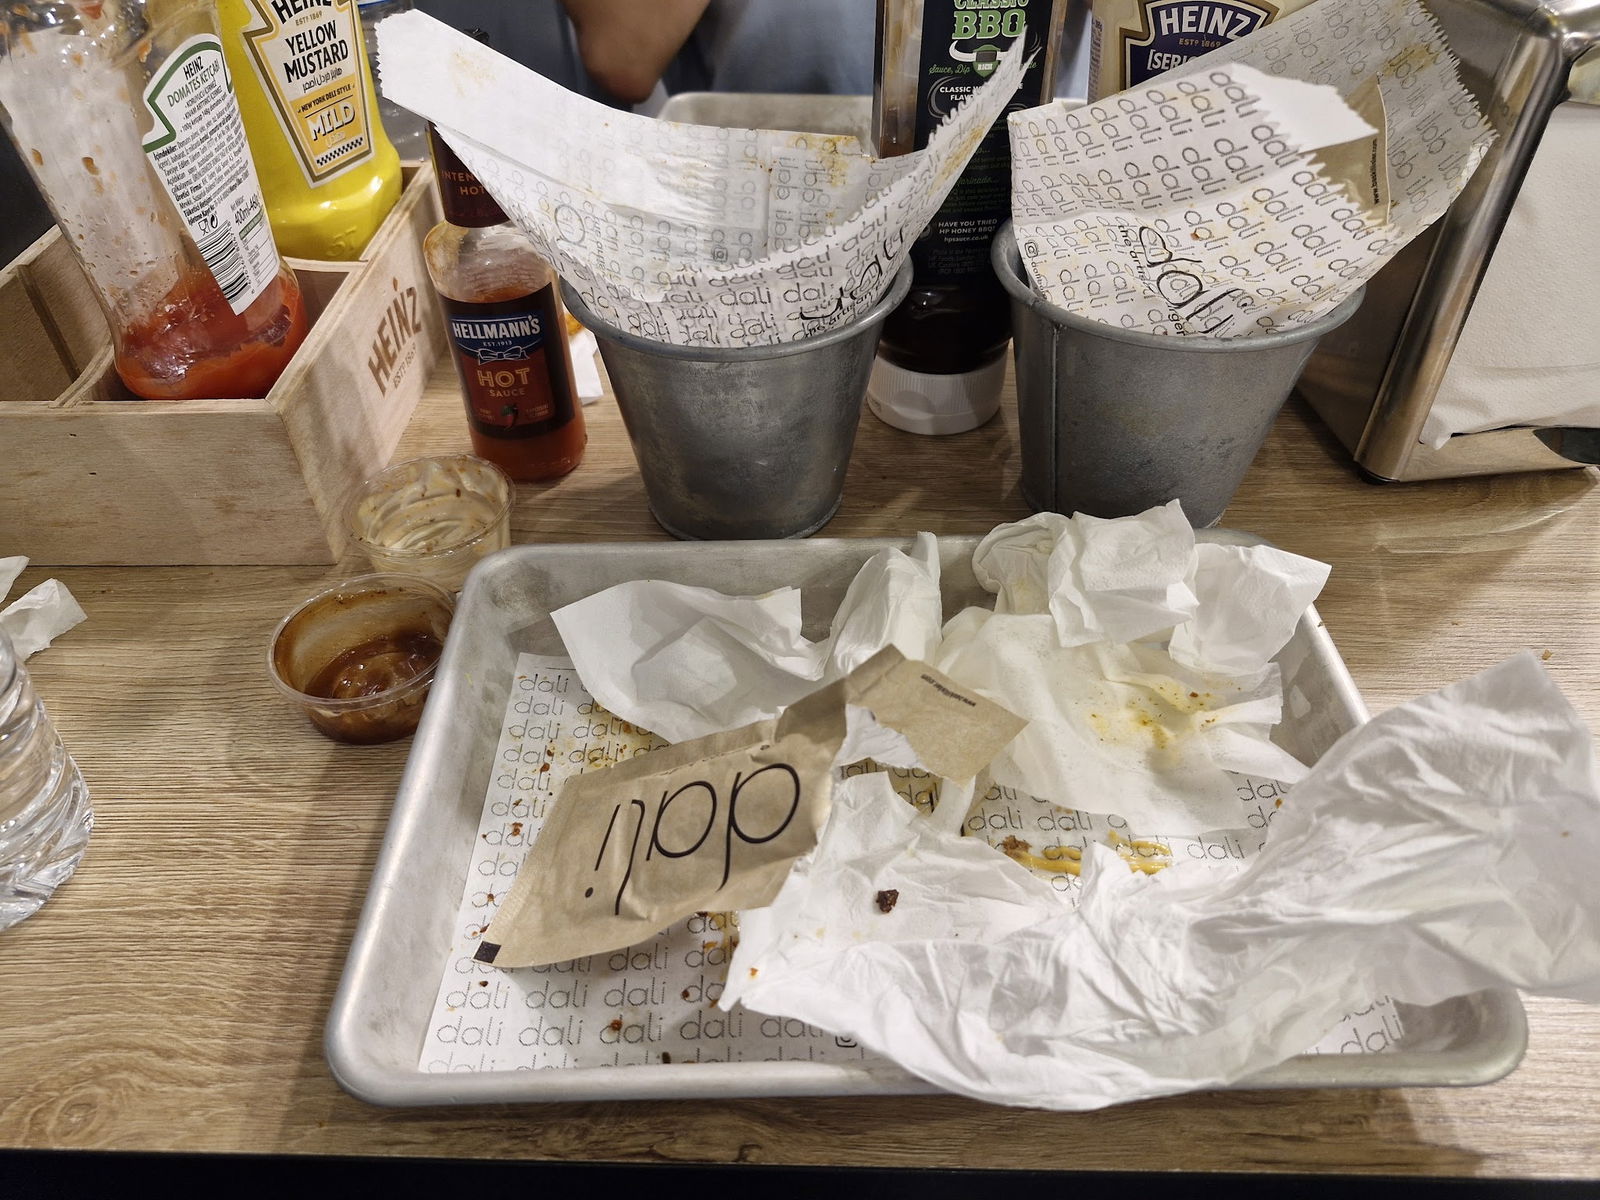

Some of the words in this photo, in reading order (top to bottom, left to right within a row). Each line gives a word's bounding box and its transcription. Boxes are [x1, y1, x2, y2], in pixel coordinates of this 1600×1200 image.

[309, 10, 323, 21] 1869
[1159, 5, 1251, 39] HEINZ
[285, 20, 337, 56] YELLOW
[1201, 39, 1221, 48] 1869
[183, 55, 204, 81] HEINZ
[283, 39, 349, 84] MUSTARD
[167, 76, 201, 108] DOMATES
[301, 102, 313, 113] NEW
[313, 95, 326, 107] YORK
[325, 90, 337, 101] DELI
[337, 84, 352, 96] STYLE
[939, 86, 972, 94] CLASSIC
[1176, 81, 1226, 128] dali
[306, 101, 357, 142] MILD
[1090, 106, 1133, 152] dali
[1117, 98, 1162, 144] dali
[1146, 89, 1193, 136] dali
[1028, 121, 1059, 166] dali
[1046, 118, 1080, 165] dali
[1065, 113, 1106, 159] dali
[1182, 147, 1227, 195] dali
[1214, 137, 1264, 184] dali
[460, 186, 486, 195] HOT
[1124, 161, 1163, 209] dali
[1152, 154, 1193, 202] dali
[976, 218, 998, 226] TRIED
[1216, 201, 1266, 240] dali
[1252, 187, 1304, 223] dali
[1184, 210, 1229, 251] dali
[1291, 224, 1341, 258] dali
[1254, 241, 1303, 275] dali
[720, 285, 772, 306] dali
[1060, 269, 1084, 312] dali
[1083, 263, 1107, 309] dali
[1106, 260, 1134, 304] dali
[368, 278, 422, 398] HEINZ
[452, 314, 541, 340] HELLMANN'S
[476, 367, 531, 389] HOT
[488, 386, 526, 398] SAUCE
[519, 673, 569, 693] dali
[514, 696, 565, 716] dali
[508, 719, 561, 740] dali
[497, 767, 552, 791] dali
[491, 794, 546, 819] dali
[967, 806, 1023, 831] dali
[1037, 809, 1093, 831] dali
[582, 762, 801, 918] dali
[1186, 835, 1245, 859] dali
[608, 942, 669, 972] dali
[446, 980, 511, 1009] dali
[526, 979, 589, 1009] dali
[604, 976, 666, 1008] dali
[437, 1015, 503, 1047] dali
[519, 1014, 583, 1047] dali
[600, 1011, 663, 1045] dali
[680, 1009, 743, 1041] dali
